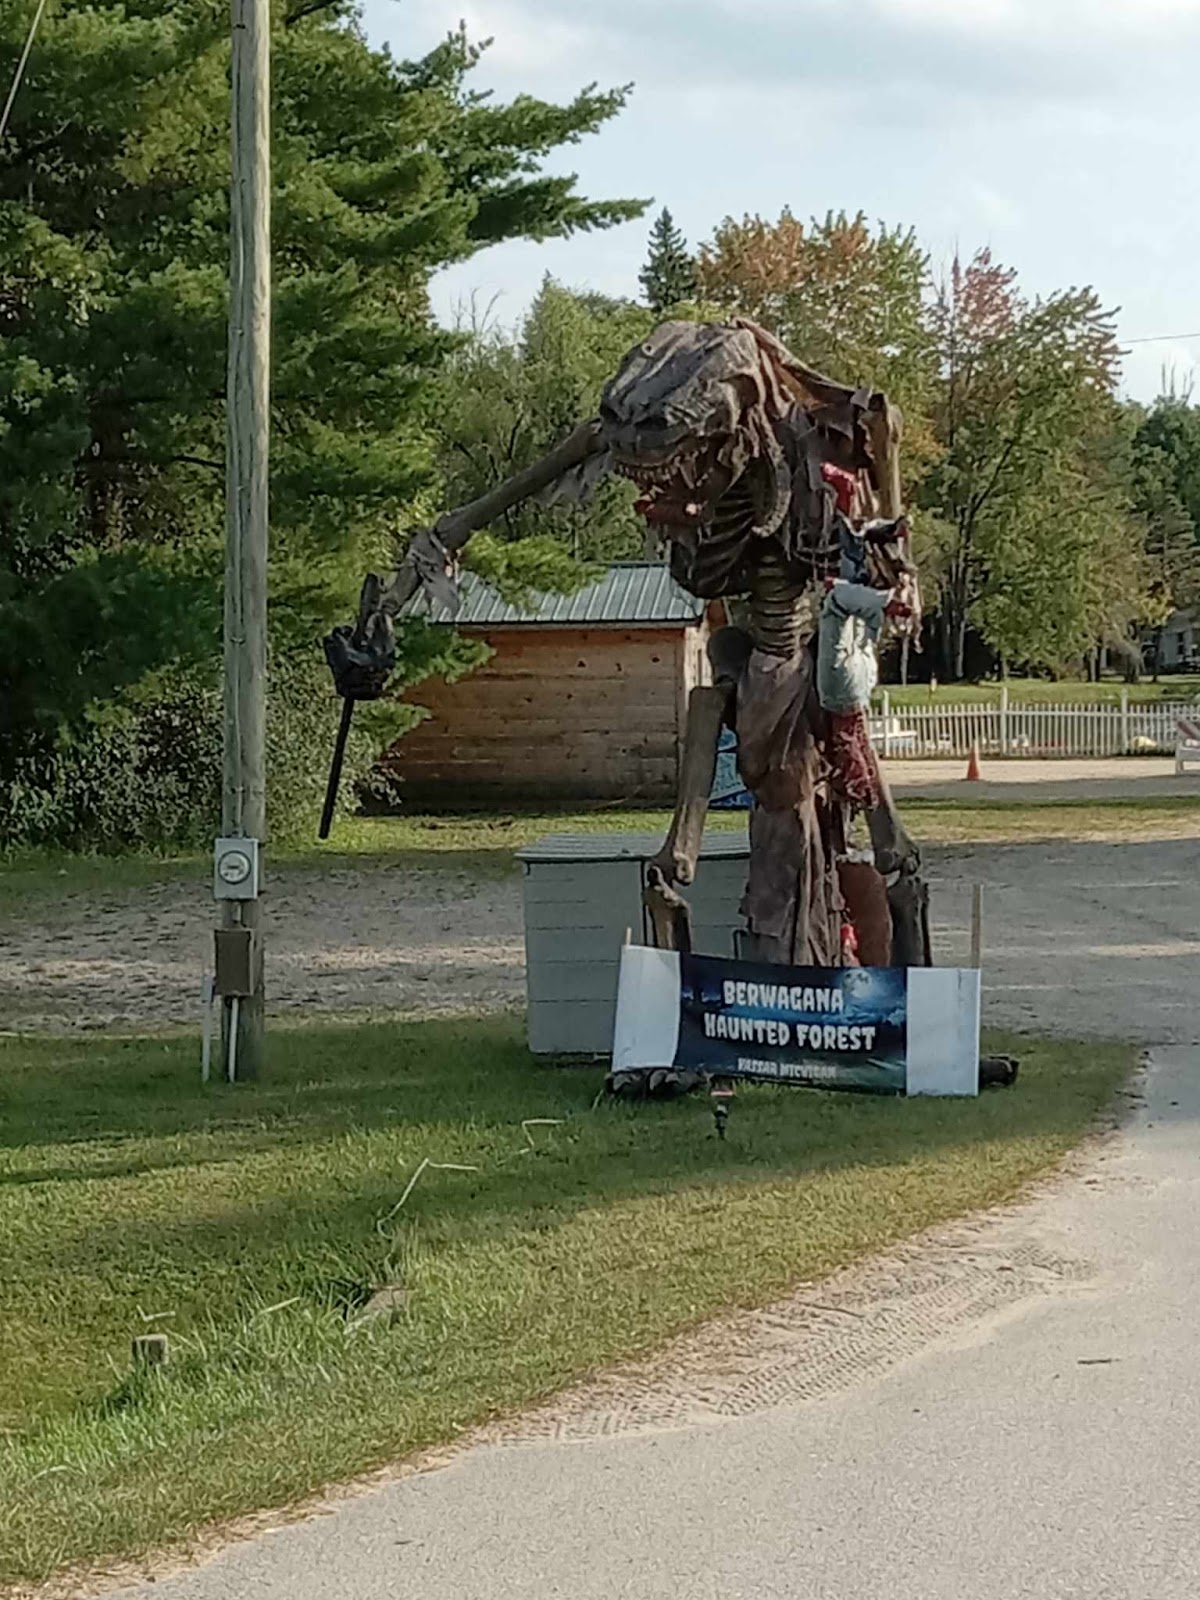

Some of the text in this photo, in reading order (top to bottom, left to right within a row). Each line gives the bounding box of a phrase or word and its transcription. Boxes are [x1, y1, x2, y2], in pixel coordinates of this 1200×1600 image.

[723, 980, 843, 1012] BERWAGANA
[704, 1013, 876, 1051] HAUNTED FOREST
[738, 1058, 777, 1075] VASSAR
